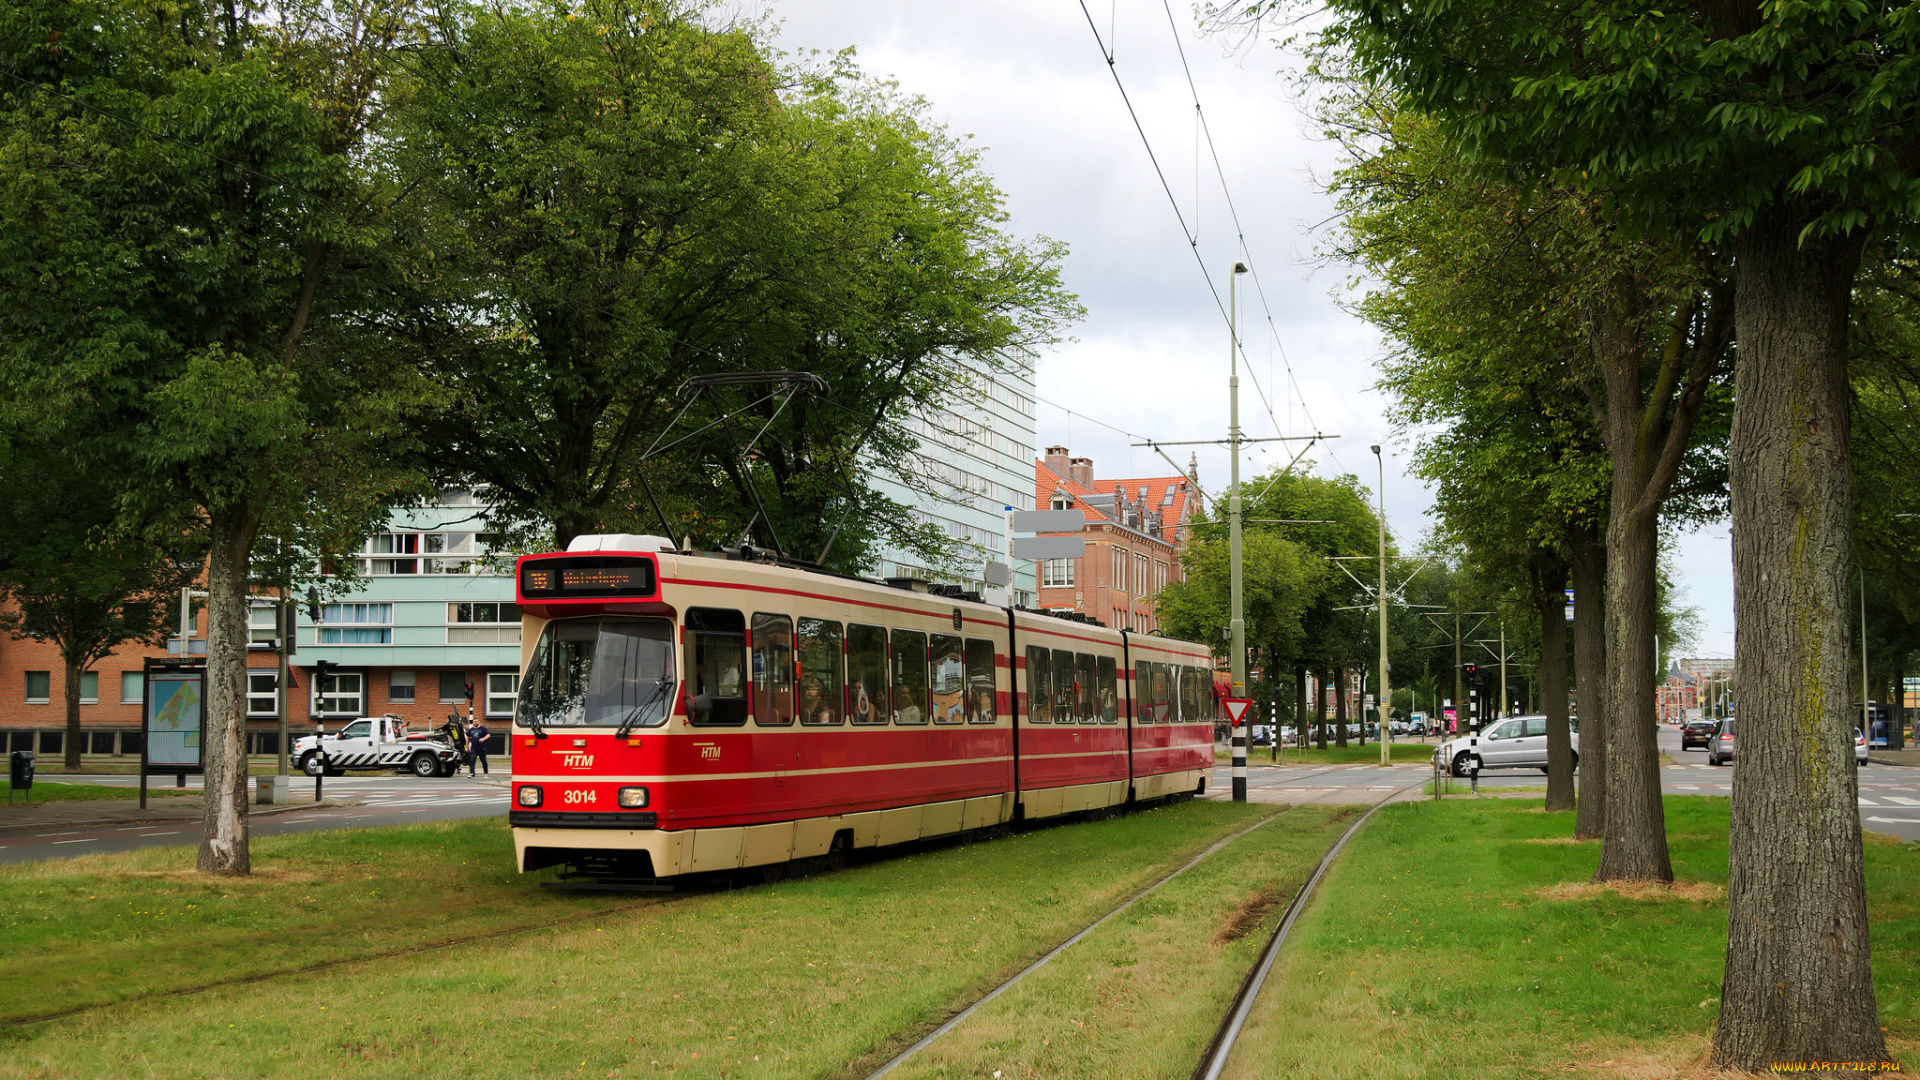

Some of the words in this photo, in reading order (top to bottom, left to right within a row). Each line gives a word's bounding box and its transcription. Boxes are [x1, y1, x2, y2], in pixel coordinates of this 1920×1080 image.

[701, 747, 721, 758] HTM
[563, 755, 594, 767] HTM
[564, 790, 597, 804] 3014
